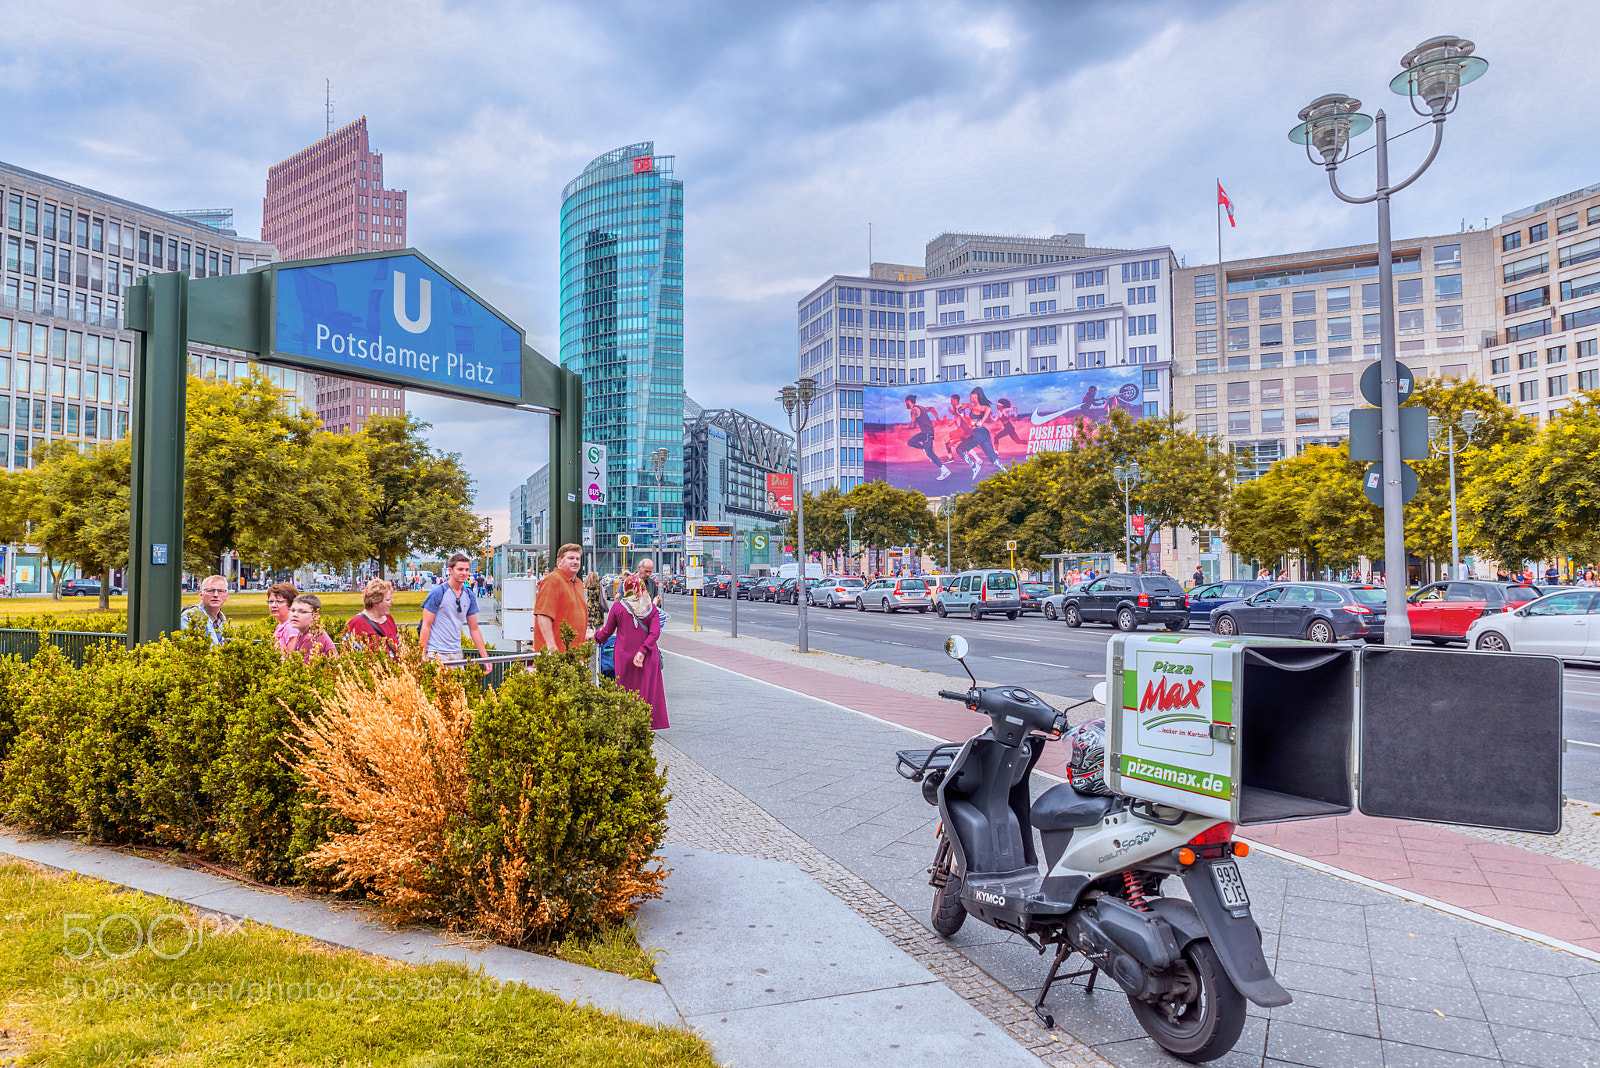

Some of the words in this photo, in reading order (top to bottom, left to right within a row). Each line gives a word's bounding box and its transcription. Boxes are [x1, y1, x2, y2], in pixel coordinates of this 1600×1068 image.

[635, 159, 650, 171] DB
[394, 270, 431, 334] U
[316, 323, 440, 373] Potsdamer
[447, 352, 494, 385] Platz
[1029, 425, 1057, 441] PUSH
[588, 488, 600, 496] BUS
[754, 535, 766, 550] S
[1153, 661, 1193, 674] Pizza
[1140, 675, 1205, 713] Max
[1126, 758, 1224, 793] pizzamax.de
[1216, 866, 1238, 883] 993
[976, 890, 1006, 906] KYMCO
[1223, 886, 1246, 904] CJE
